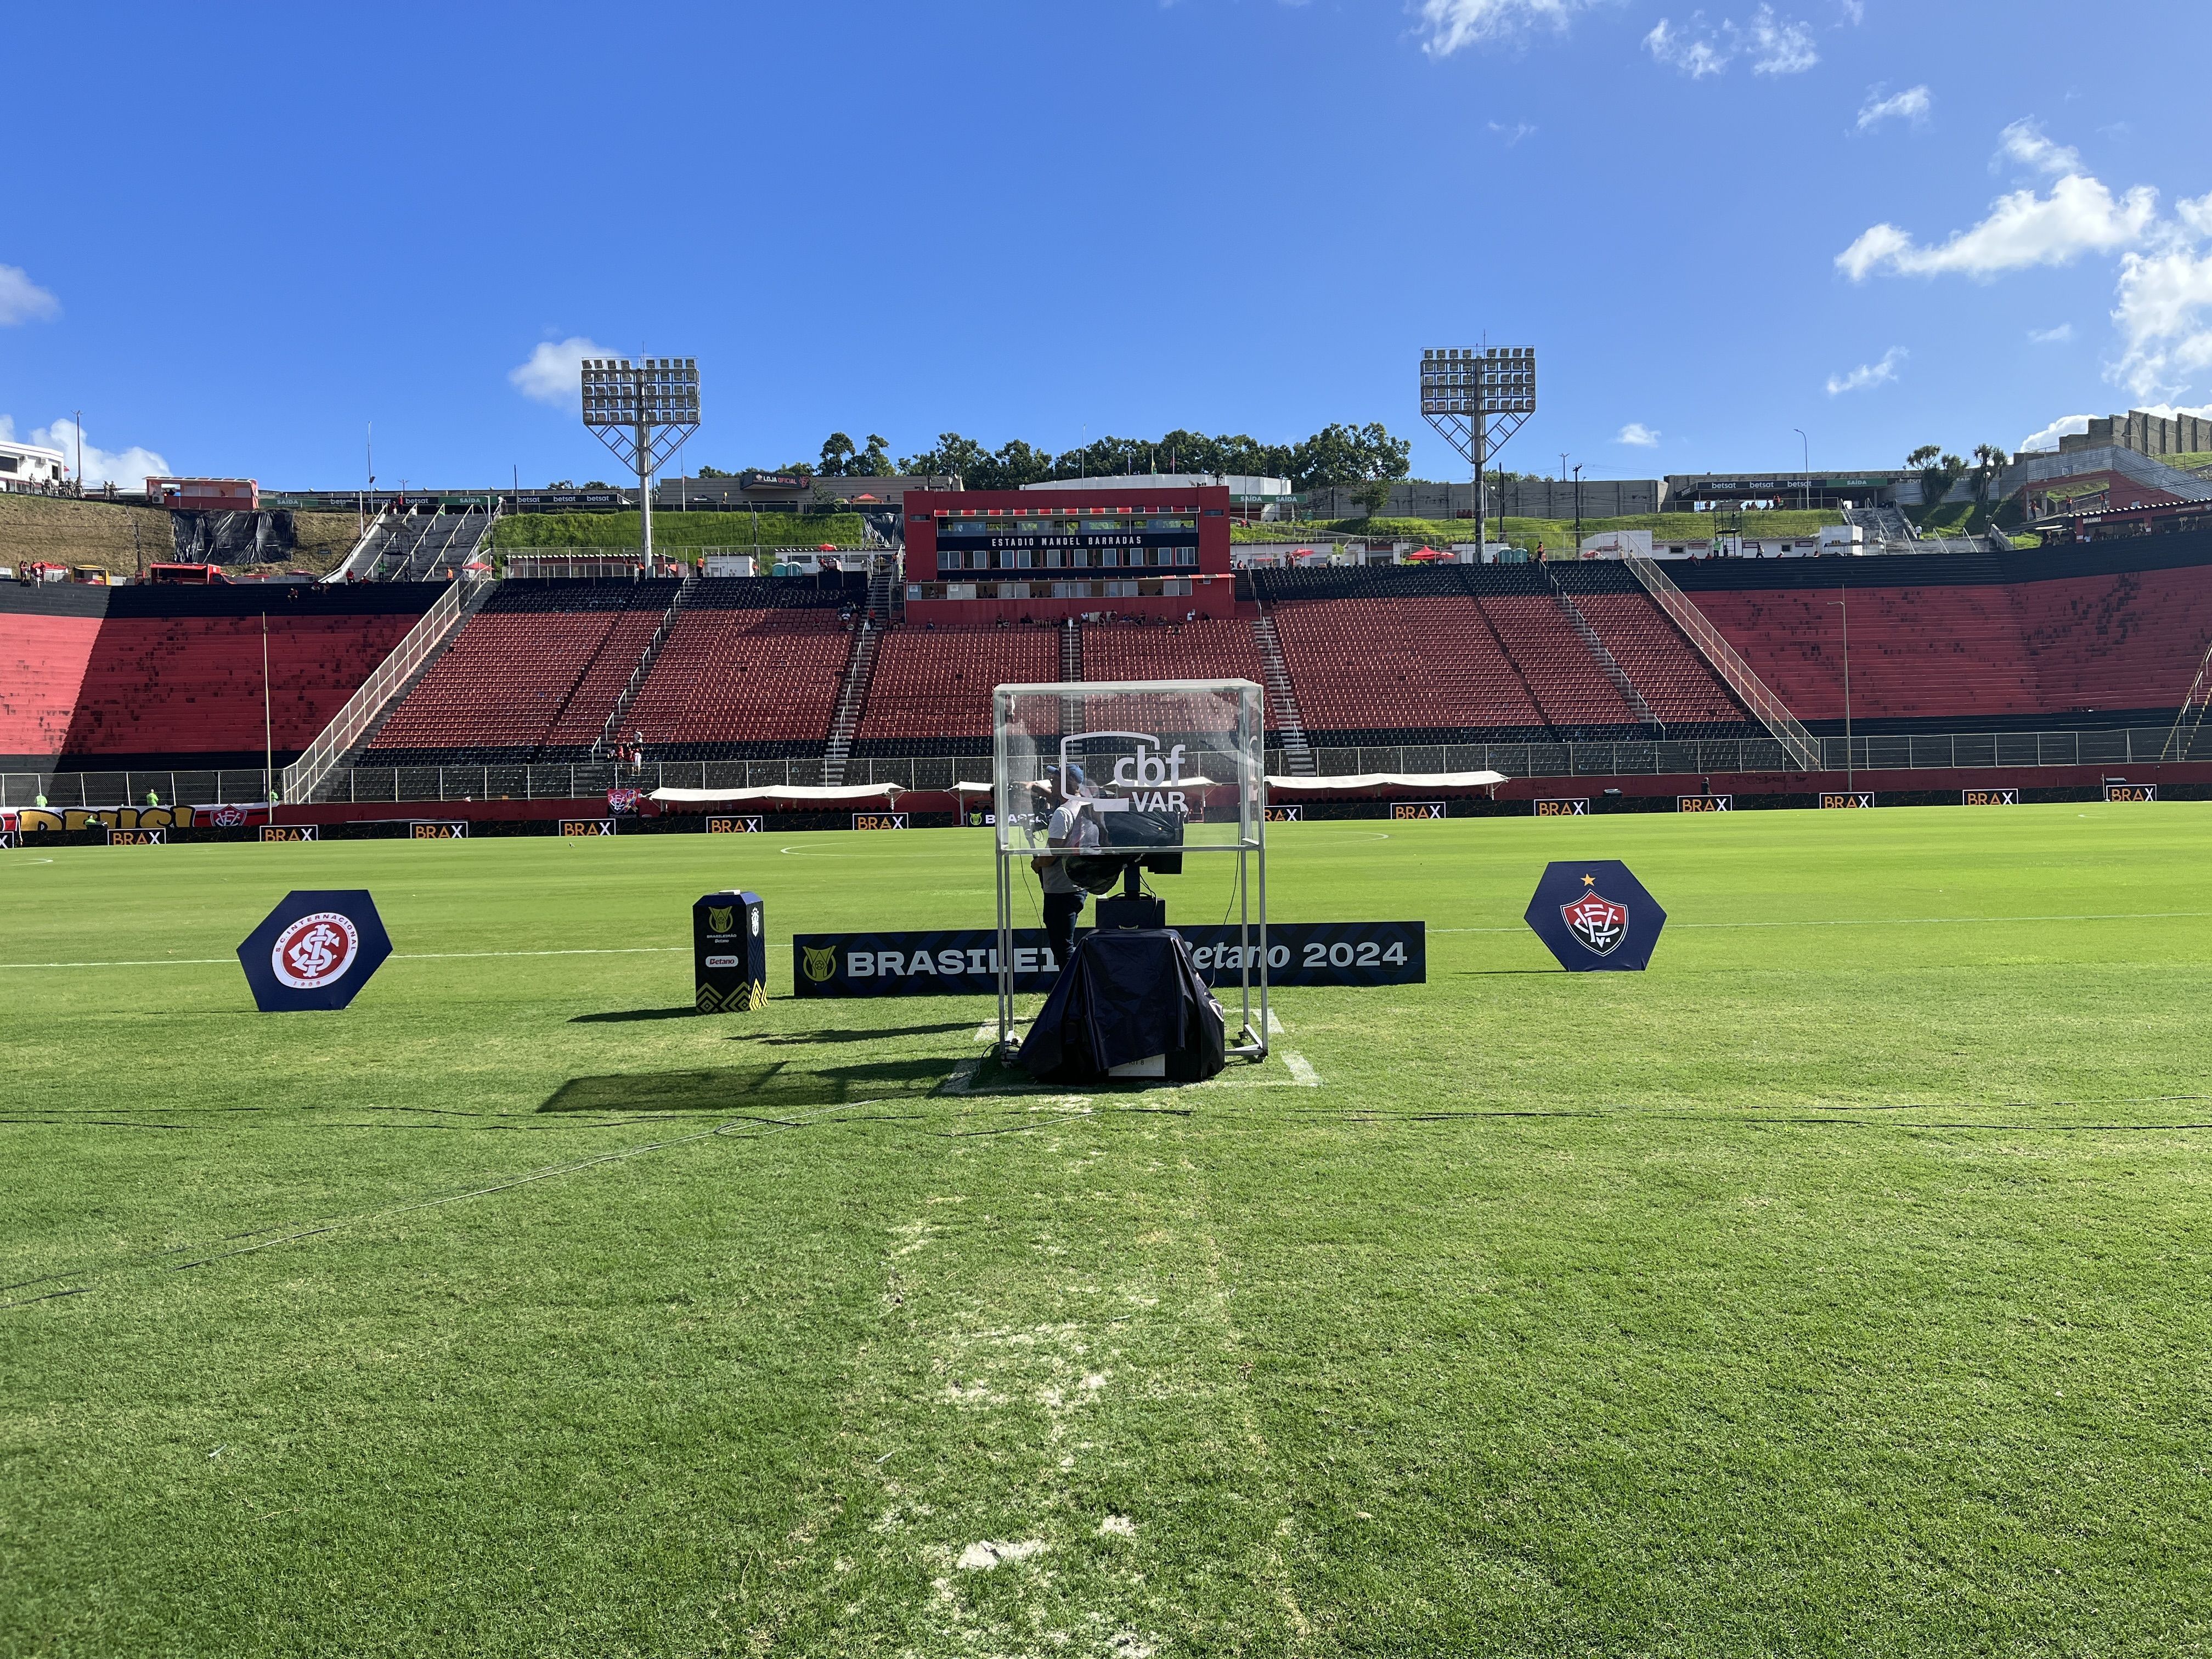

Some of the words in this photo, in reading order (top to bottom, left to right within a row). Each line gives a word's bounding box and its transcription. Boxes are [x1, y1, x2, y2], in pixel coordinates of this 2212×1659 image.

[992, 538, 1034, 546] ESTADIO
[1042, 537, 1080, 546] MANOEL
[1088, 536, 1142, 545] BARRADAS
[1114, 744, 1186, 787] cbf
[1825, 795, 1869, 808] BRAX
[1968, 792, 2013, 805] BRAX
[2112, 788, 2154, 802] BRAX
[1132, 792, 1187, 812] VAR
[1539, 802, 1584, 815] BRAX
[1683, 798, 1727, 812] BRAX
[1265, 809, 1297, 821] RAX
[1396, 806, 1441, 819] BRAX
[564, 822, 611, 836] BRAX
[711, 819, 758, 833] BRAX
[857, 816, 904, 830] BRAX
[265, 828, 312, 841] BRAX
[415, 825, 463, 838] BRAX
[113, 832, 160, 845] BRAX
[287, 913, 357, 951] INTERNACIONAL
[848, 947, 1060, 977] BRASILEI
[1303, 941, 1408, 967] 2024
